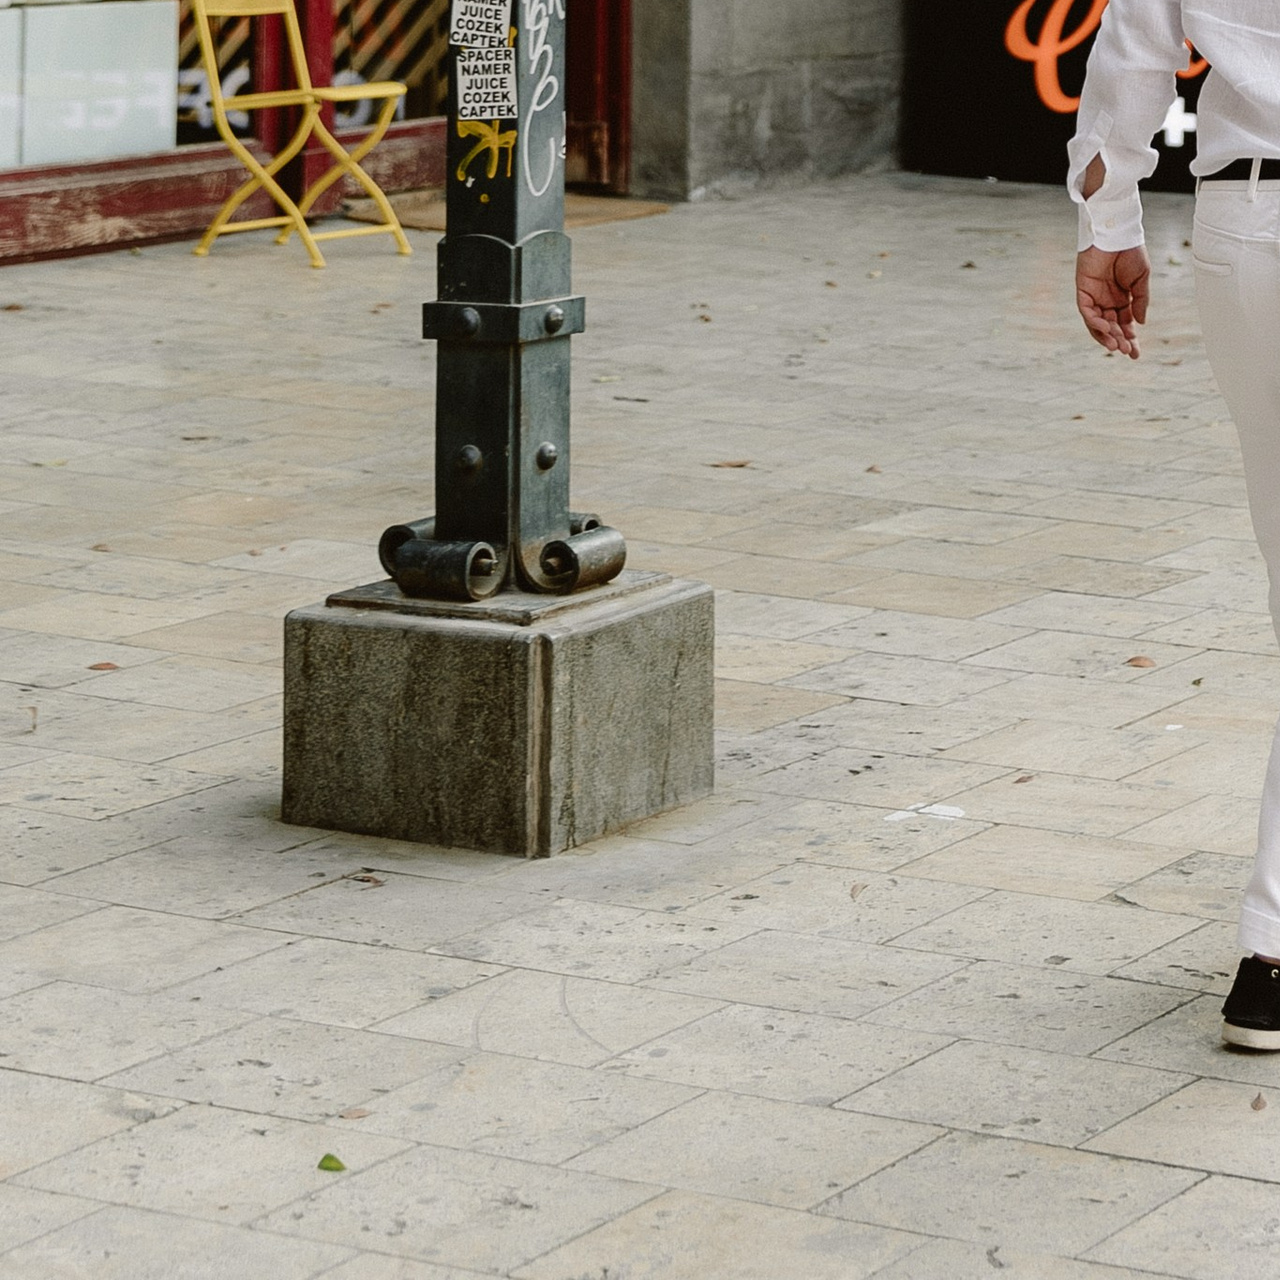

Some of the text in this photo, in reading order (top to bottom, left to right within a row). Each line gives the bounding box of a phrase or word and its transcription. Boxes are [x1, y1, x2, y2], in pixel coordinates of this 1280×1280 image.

[460, 5, 503, 21] JUICE
[456, 18, 504, 35] COZEK
[451, 31, 508, 48] CAPTEK
[459, 49, 513, 62] SPACER
[461, 63, 511, 76] NAMER
[466, 77, 507, 90] JUICE
[463, 91, 511, 104] COZEK
[459, 104, 516, 118] CAPTEK
